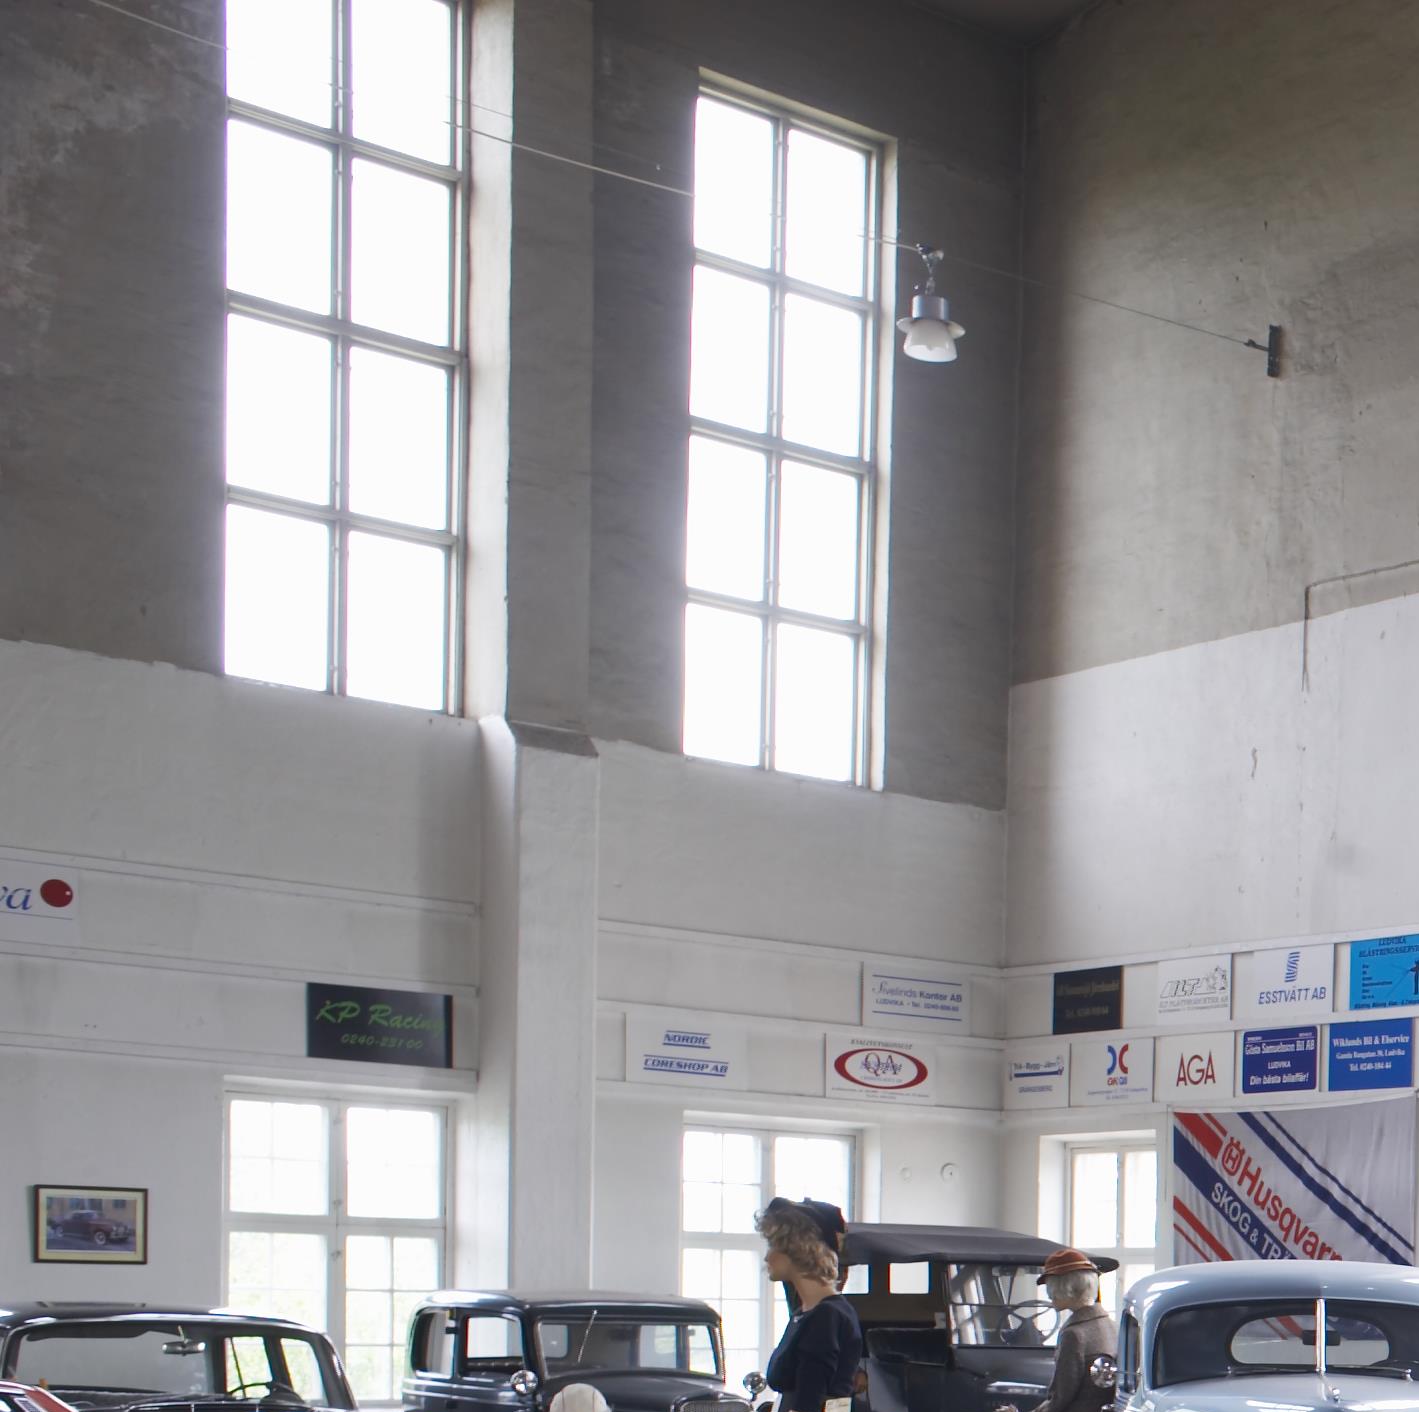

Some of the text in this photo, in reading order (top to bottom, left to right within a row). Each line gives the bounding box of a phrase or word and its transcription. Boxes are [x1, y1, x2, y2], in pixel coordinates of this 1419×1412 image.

[950, 993, 962, 1003] AB
[1311, 986, 1327, 1000] AB
[316, 1000, 445, 1040] KP Racing
[664, 1033, 710, 1045] NORDIC
[1305, 1039, 1315, 1050] AB
[1373, 1035, 1380, 1045] &
[711, 1064, 728, 1074] AB
[1176, 1050, 1216, 1087] AGA
[1267, 1061, 1291, 1069] LUDVIKA
[1249, 1075, 1262, 1086] Din
[1212, 1183, 1251, 1234] SKOG
[1250, 1228, 1259, 1246] &
